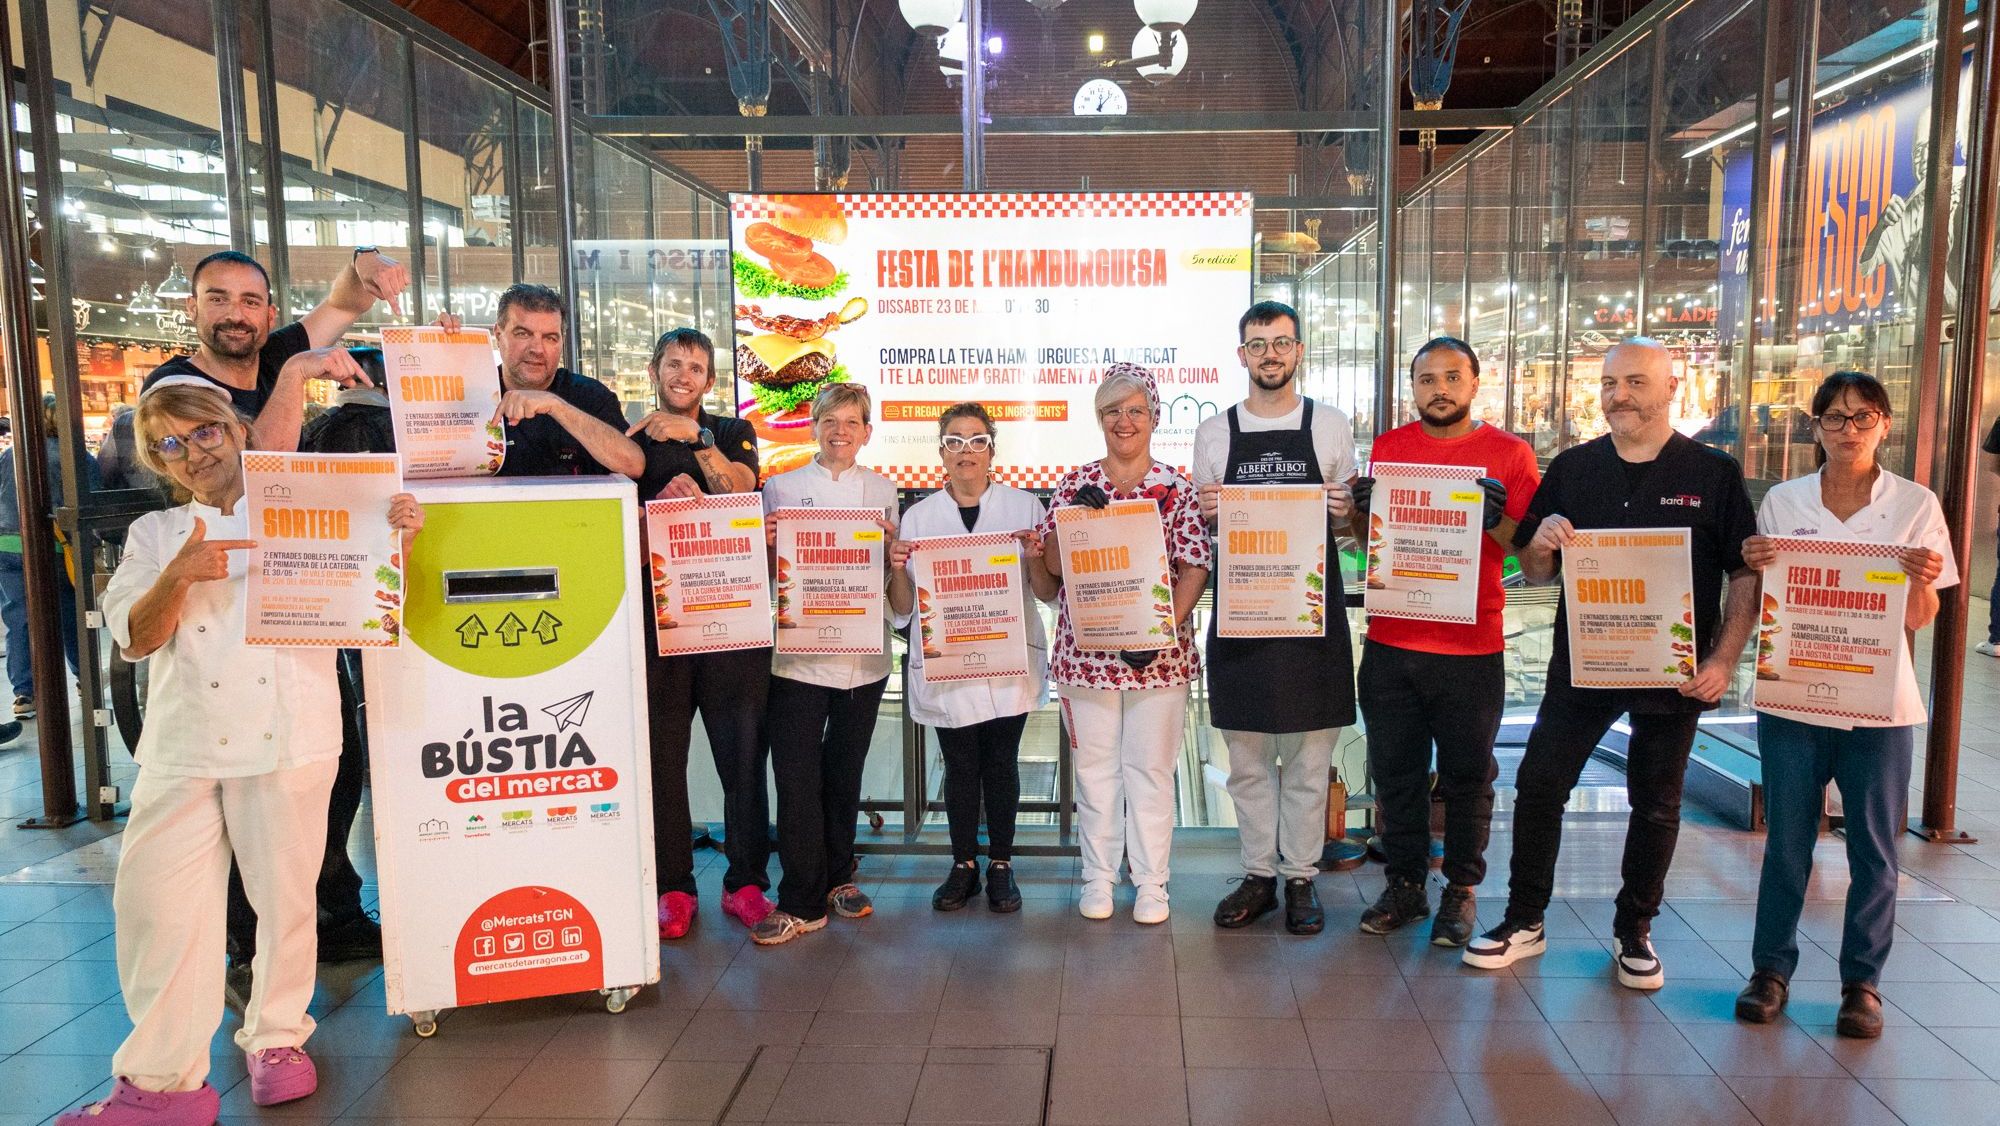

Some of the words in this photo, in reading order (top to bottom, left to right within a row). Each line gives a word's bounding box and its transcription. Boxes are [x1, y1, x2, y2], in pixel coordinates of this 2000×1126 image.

[1207, 253, 1238, 265] edició
[877, 249, 939, 288] FESTA
[948, 249, 974, 288] DE
[982, 249, 1167, 288] L'HAMBURGUESA
[878, 299, 933, 314] DISSABTE
[937, 299, 951, 314] 23
[954, 299, 969, 314] DE
[880, 348, 935, 364] COMPRA
[940, 348, 956, 364] LA
[960, 348, 993, 364] TEVA
[997, 348, 1099, 364] HAMURGUESA
[1103, 348, 1118, 364] AL
[1123, 348, 1177, 364] MERCAT
[880, 368, 884, 384] I
[888, 368, 903, 384] TE
[908, 368, 924, 384] LA
[928, 368, 979, 384] CUINEM
[1089, 368, 1097, 384] A
[1179, 368, 1219, 384] CUINA
[902, 406, 913, 417] ET
[988, 406, 1003, 417] ELS
[291, 461, 315, 473] FESTA
[1237, 464, 1273, 474] ALBERT
[1276, 463, 1306, 472] RIBOT
[1389, 488, 1417, 505] FESTA
[1420, 490, 1431, 506] DE
[1388, 506, 1467, 526] L'HAMBURGUESA
[668, 523, 697, 540] FESTA
[700, 522, 712, 538] DE
[796, 532, 821, 546] FESTA
[825, 532, 835, 546] DE
[670, 536, 751, 558] L'HAMBURGUESA
[270, 552, 302, 560] ENTRADES
[796, 548, 869, 563] L'HAMBURGUESA
[932, 560, 958, 576] FESTA
[961, 559, 972, 574] DE
[680, 572, 702, 580] COMPRA
[680, 578, 721, 588] HAMBURGUESA
[730, 576, 751, 584] MERCAT
[934, 573, 1008, 592] L'HAMBURGUESA
[1787, 566, 1822, 586] FESTA
[1826, 568, 1841, 587] DE
[700, 586, 721, 594] CUINEM
[695, 594, 716, 602] NOSTRA
[1785, 586, 1888, 611] L'HAMBURGUESA
[1791, 622, 1819, 632] COMPRA
[1820, 625, 1829, 633] LA
[1831, 626, 1848, 634] TEVA
[1790, 631, 1841, 642] HAMBURGUESA
[1852, 636, 1880, 646] MERCAT
[1794, 640, 1802, 648] TE
[1813, 642, 1839, 651] CUINEM
[1805, 650, 1831, 659] NOSTRA
[1832, 652, 1853, 661] CUINA
[483, 695, 528, 733] la
[421, 728, 596, 778] BÚSTIA
[458, 777, 500, 799] del
[508, 769, 603, 796] mercat
[481, 908, 573, 932] @MercatsTGN
[475, 953, 584, 972] mercatsdetarragona.cat
